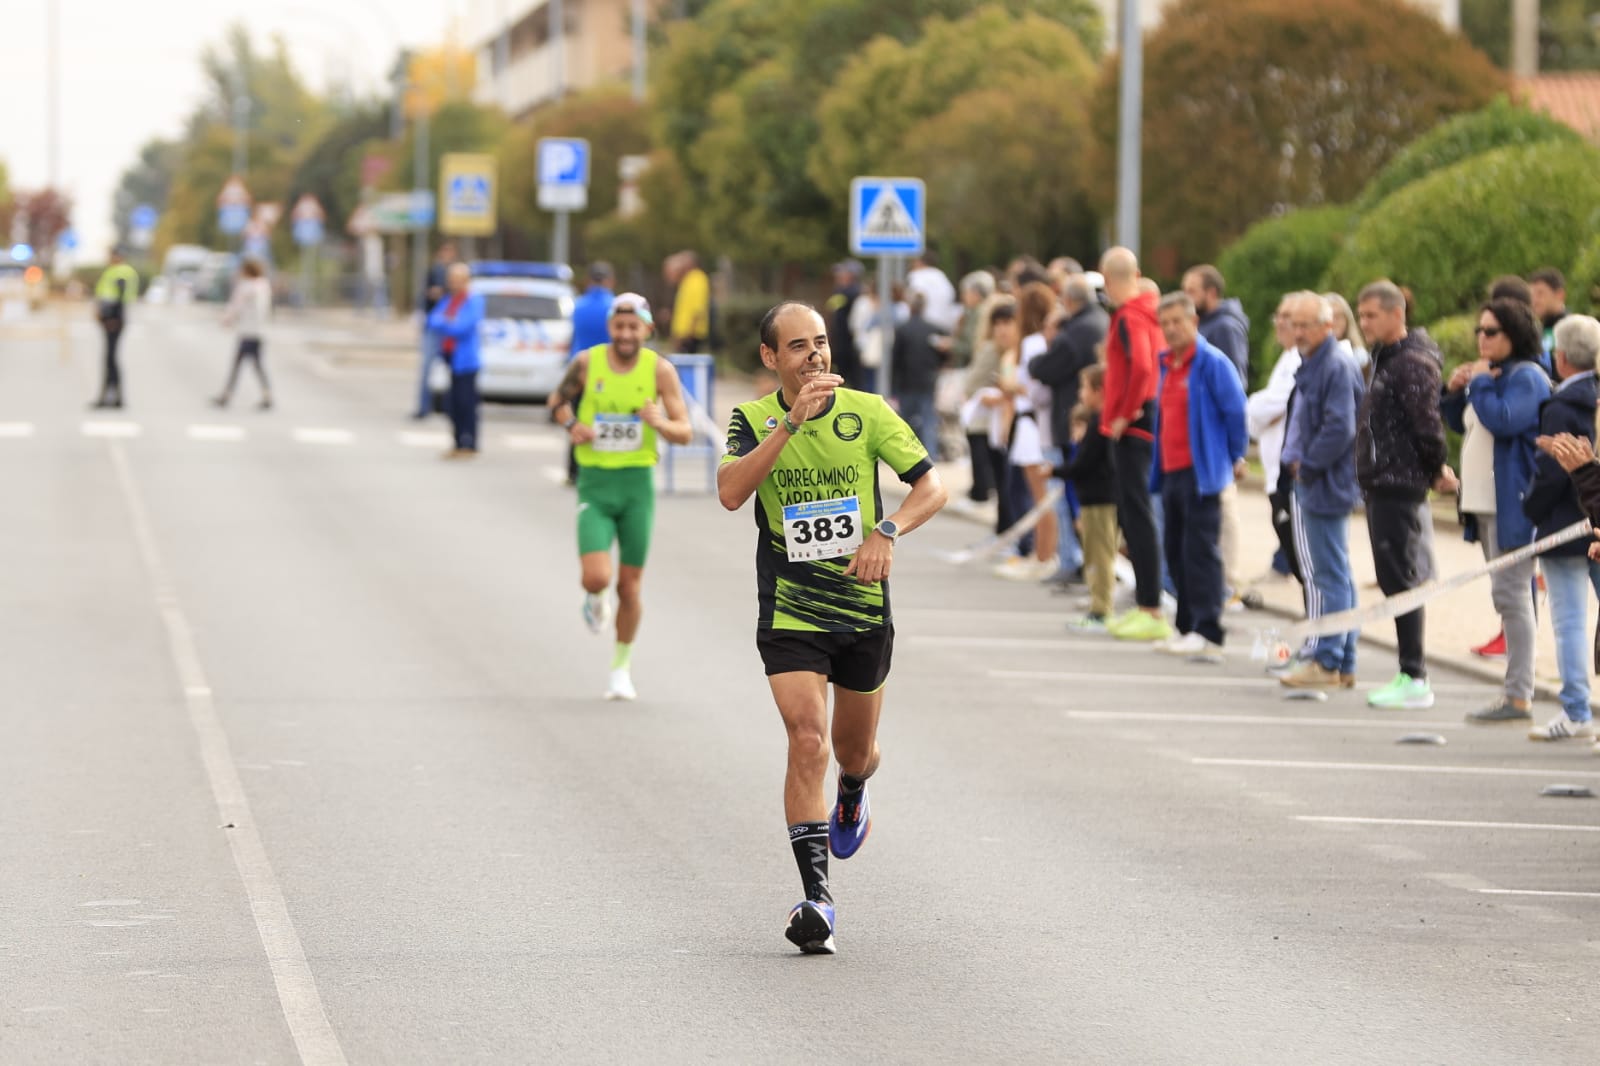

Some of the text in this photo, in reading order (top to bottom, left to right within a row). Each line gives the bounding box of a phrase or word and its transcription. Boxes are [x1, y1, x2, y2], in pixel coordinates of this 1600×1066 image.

[543, 142, 576, 183] P
[600, 423, 638, 440] 286
[772, 464, 859, 488] CORRECAMINOS
[792, 515, 854, 544] 383
